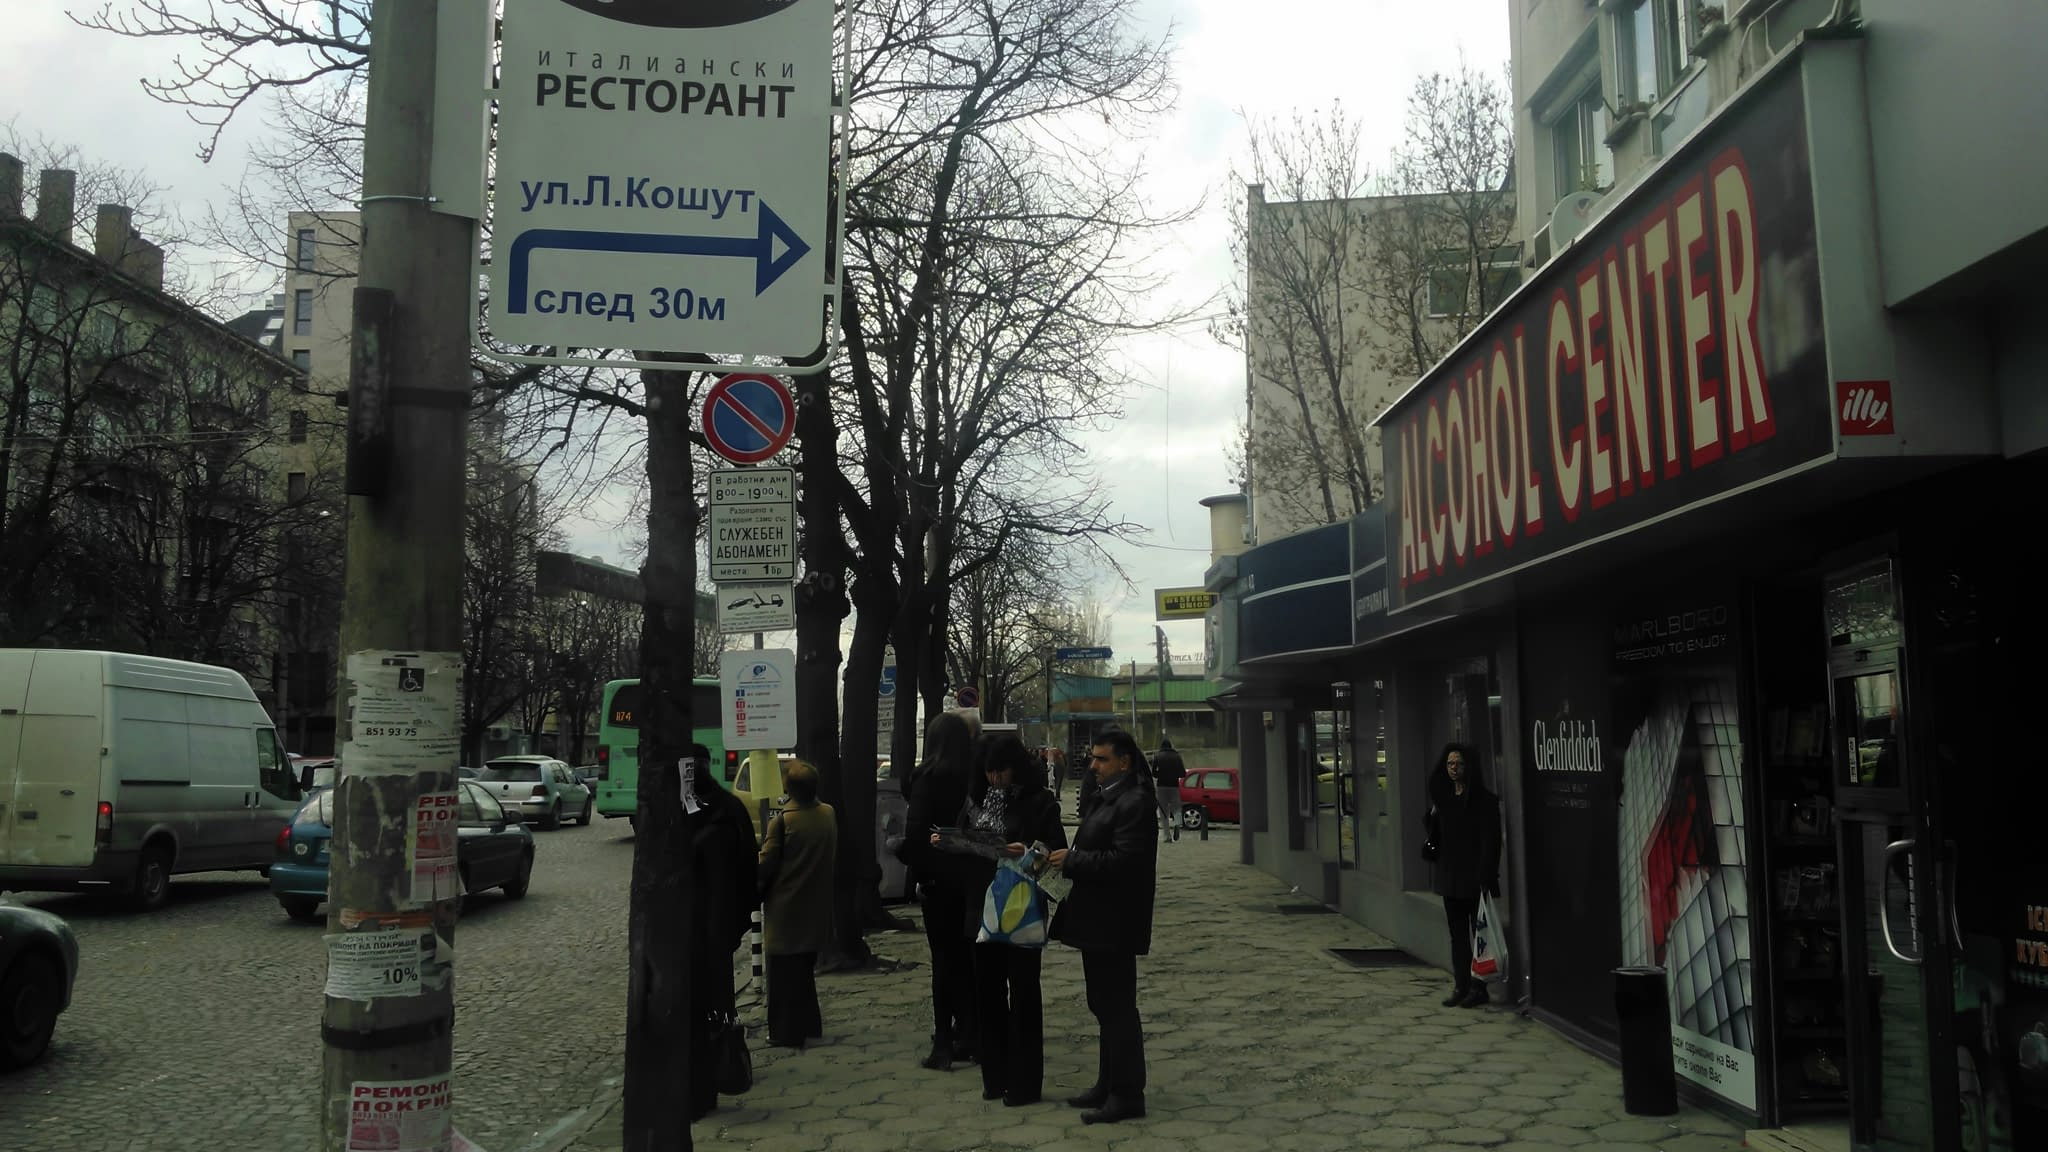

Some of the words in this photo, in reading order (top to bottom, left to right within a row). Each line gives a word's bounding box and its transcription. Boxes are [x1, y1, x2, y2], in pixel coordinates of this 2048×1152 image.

[538, 49, 794, 79] италиански
[536, 73, 796, 118] РЕСТОРАНТ
[533, 288, 635, 323] след
[649, 287, 727, 321] 30м
[1399, 325, 1544, 588] ALCOHOL
[1548, 146, 1777, 524] CENTER
[1842, 387, 1890, 429] illy
[770, 475, 787, 484] дни
[720, 526, 783, 541] СЛУЖЕБЕН
[716, 544, 788, 559] АБОНАМЕНТ
[1615, 606, 1727, 640] MARLBORO
[366, 727, 384, 736] 851
[388, 727, 401, 736] 93
[404, 727, 417, 736] 75
[1533, 719, 1602, 772] Glenfiddich
[352, 1093, 451, 1112] ПОКРИ
[354, 1080, 450, 1098] РЕМОНТ
